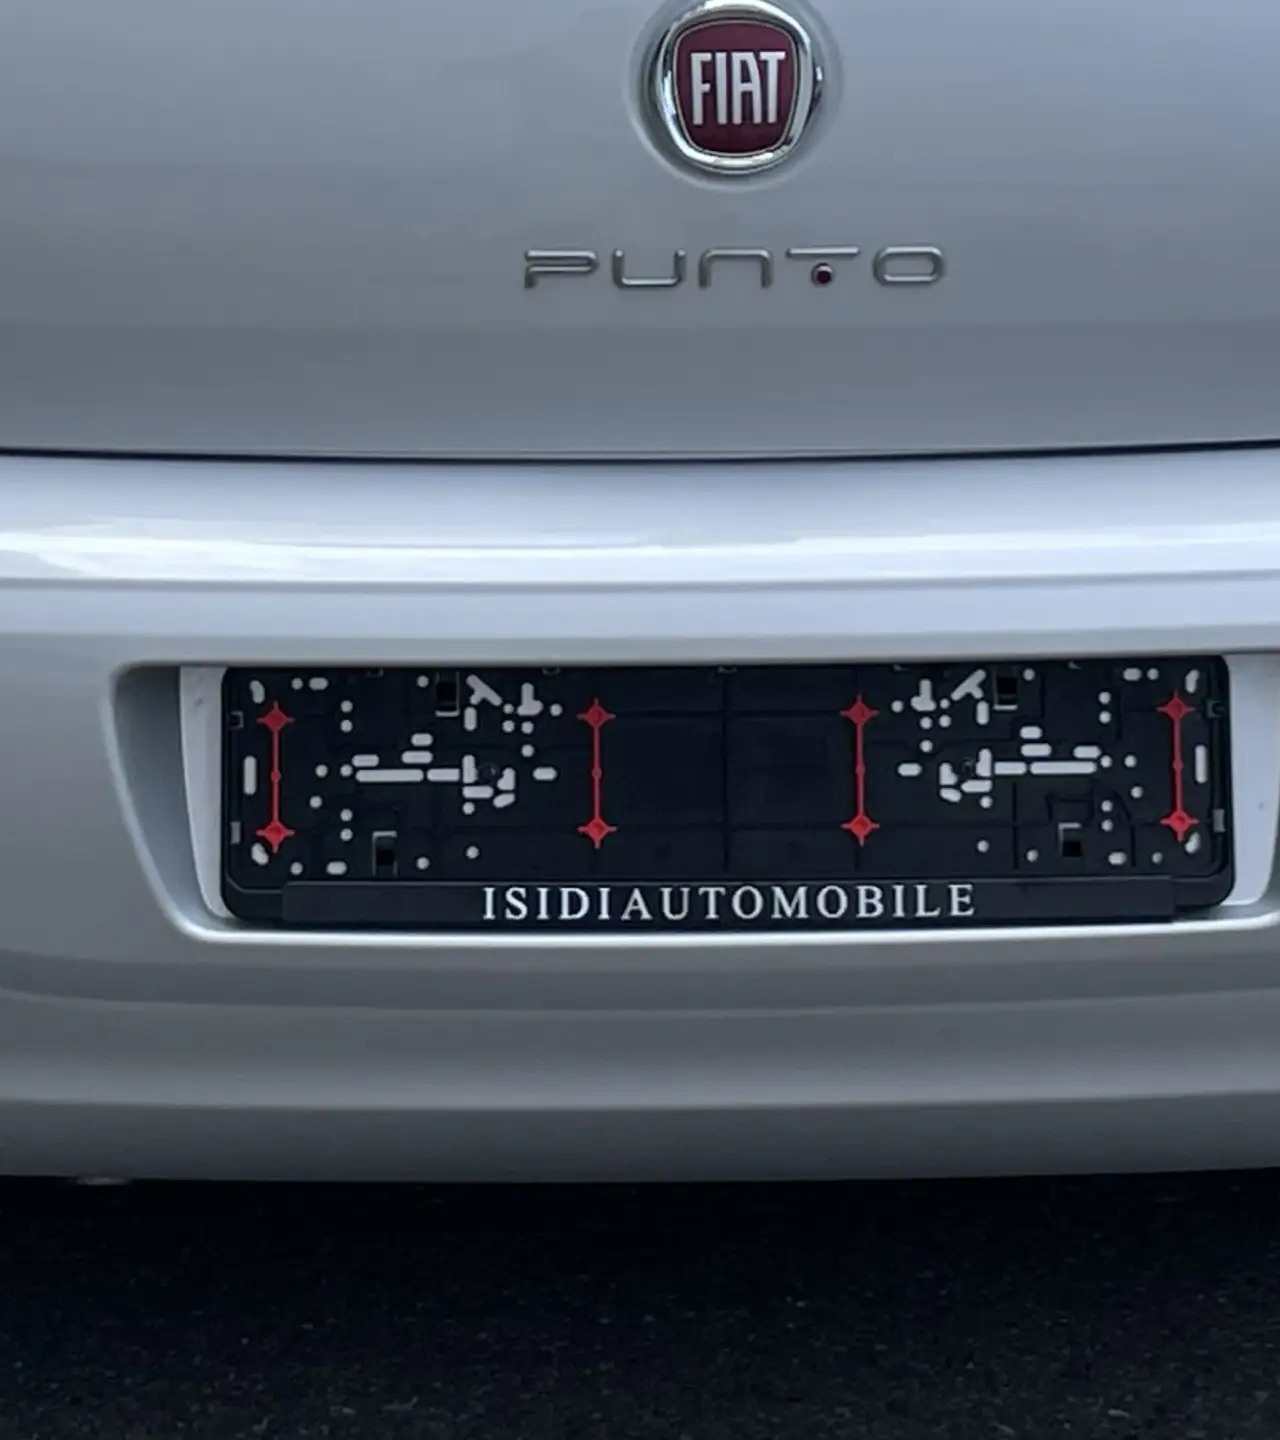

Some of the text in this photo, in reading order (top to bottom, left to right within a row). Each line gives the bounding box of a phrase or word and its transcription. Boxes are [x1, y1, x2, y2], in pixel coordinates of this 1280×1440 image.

[689, 51, 787, 126] FIAT
[523, 245, 948, 290] PUNTO
[482, 883, 977, 921] ISIDIAUTOMOBILE
